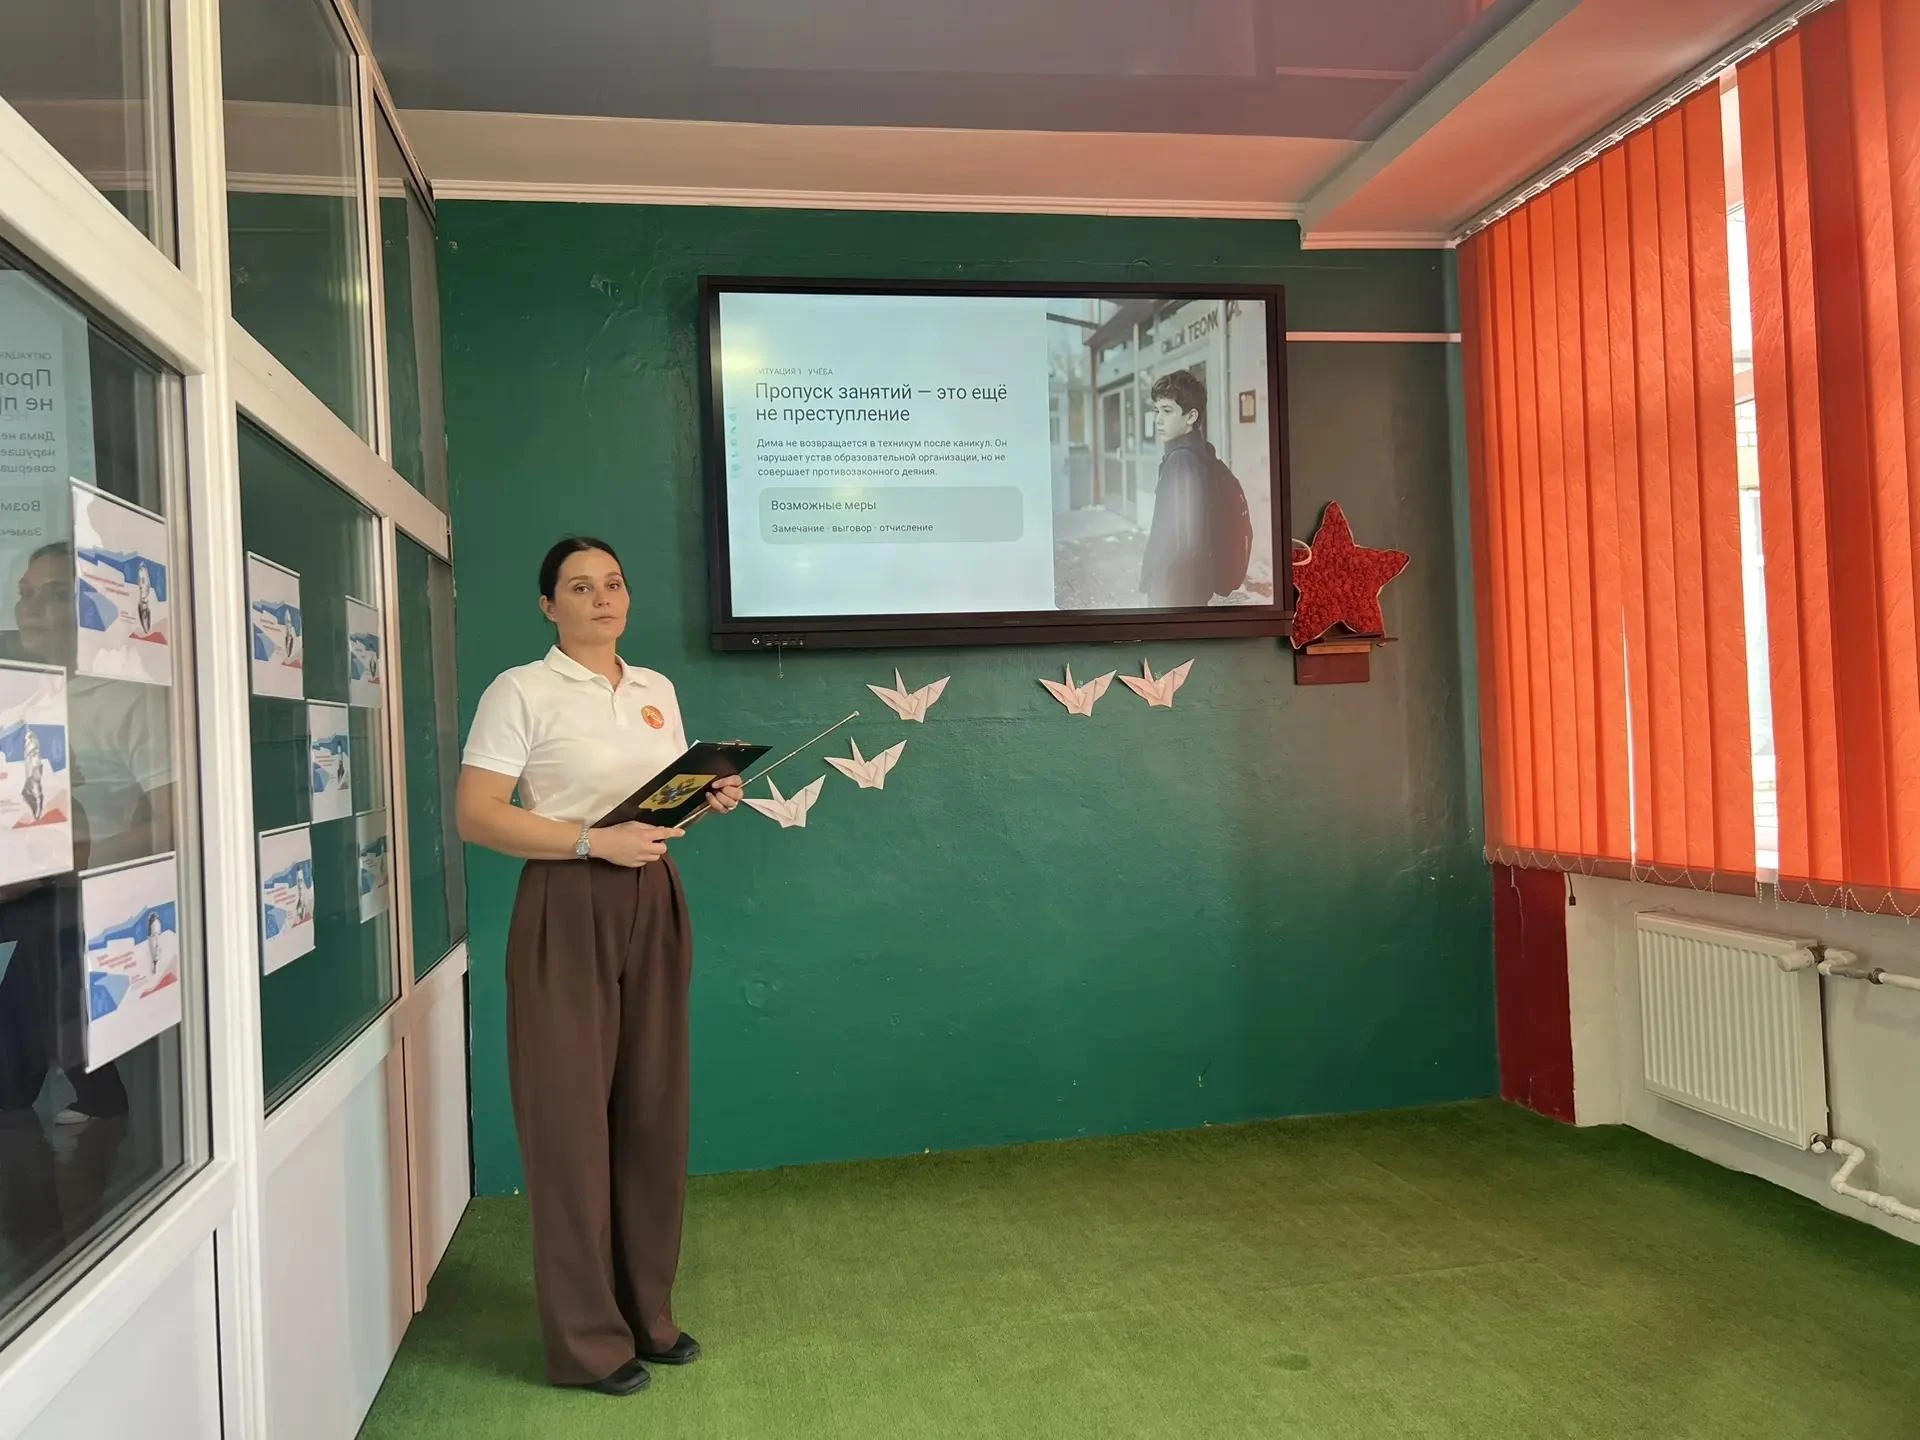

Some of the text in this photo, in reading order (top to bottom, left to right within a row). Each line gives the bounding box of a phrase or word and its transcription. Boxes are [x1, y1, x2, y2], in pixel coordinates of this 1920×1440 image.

[756, 367, 796, 377] ИТУАЦИЯ
[755, 382, 833, 403] Пропуск
[838, 383, 912, 400] занятий
[936, 387, 967, 401] это
[971, 383, 1007, 402] ещё
[756, 408, 910, 425] не преступление
[756, 438, 1008, 450] Дима не возвращается в техникум после каникул. Он
[757, 451, 1006, 464] нарушает устав образовательной организации, но не
[758, 466, 938, 478] совершает противозаконного деяния.
[771, 499, 877, 513] Возможные меры
[771, 522, 934, 534] Замечание выговор отчисление
